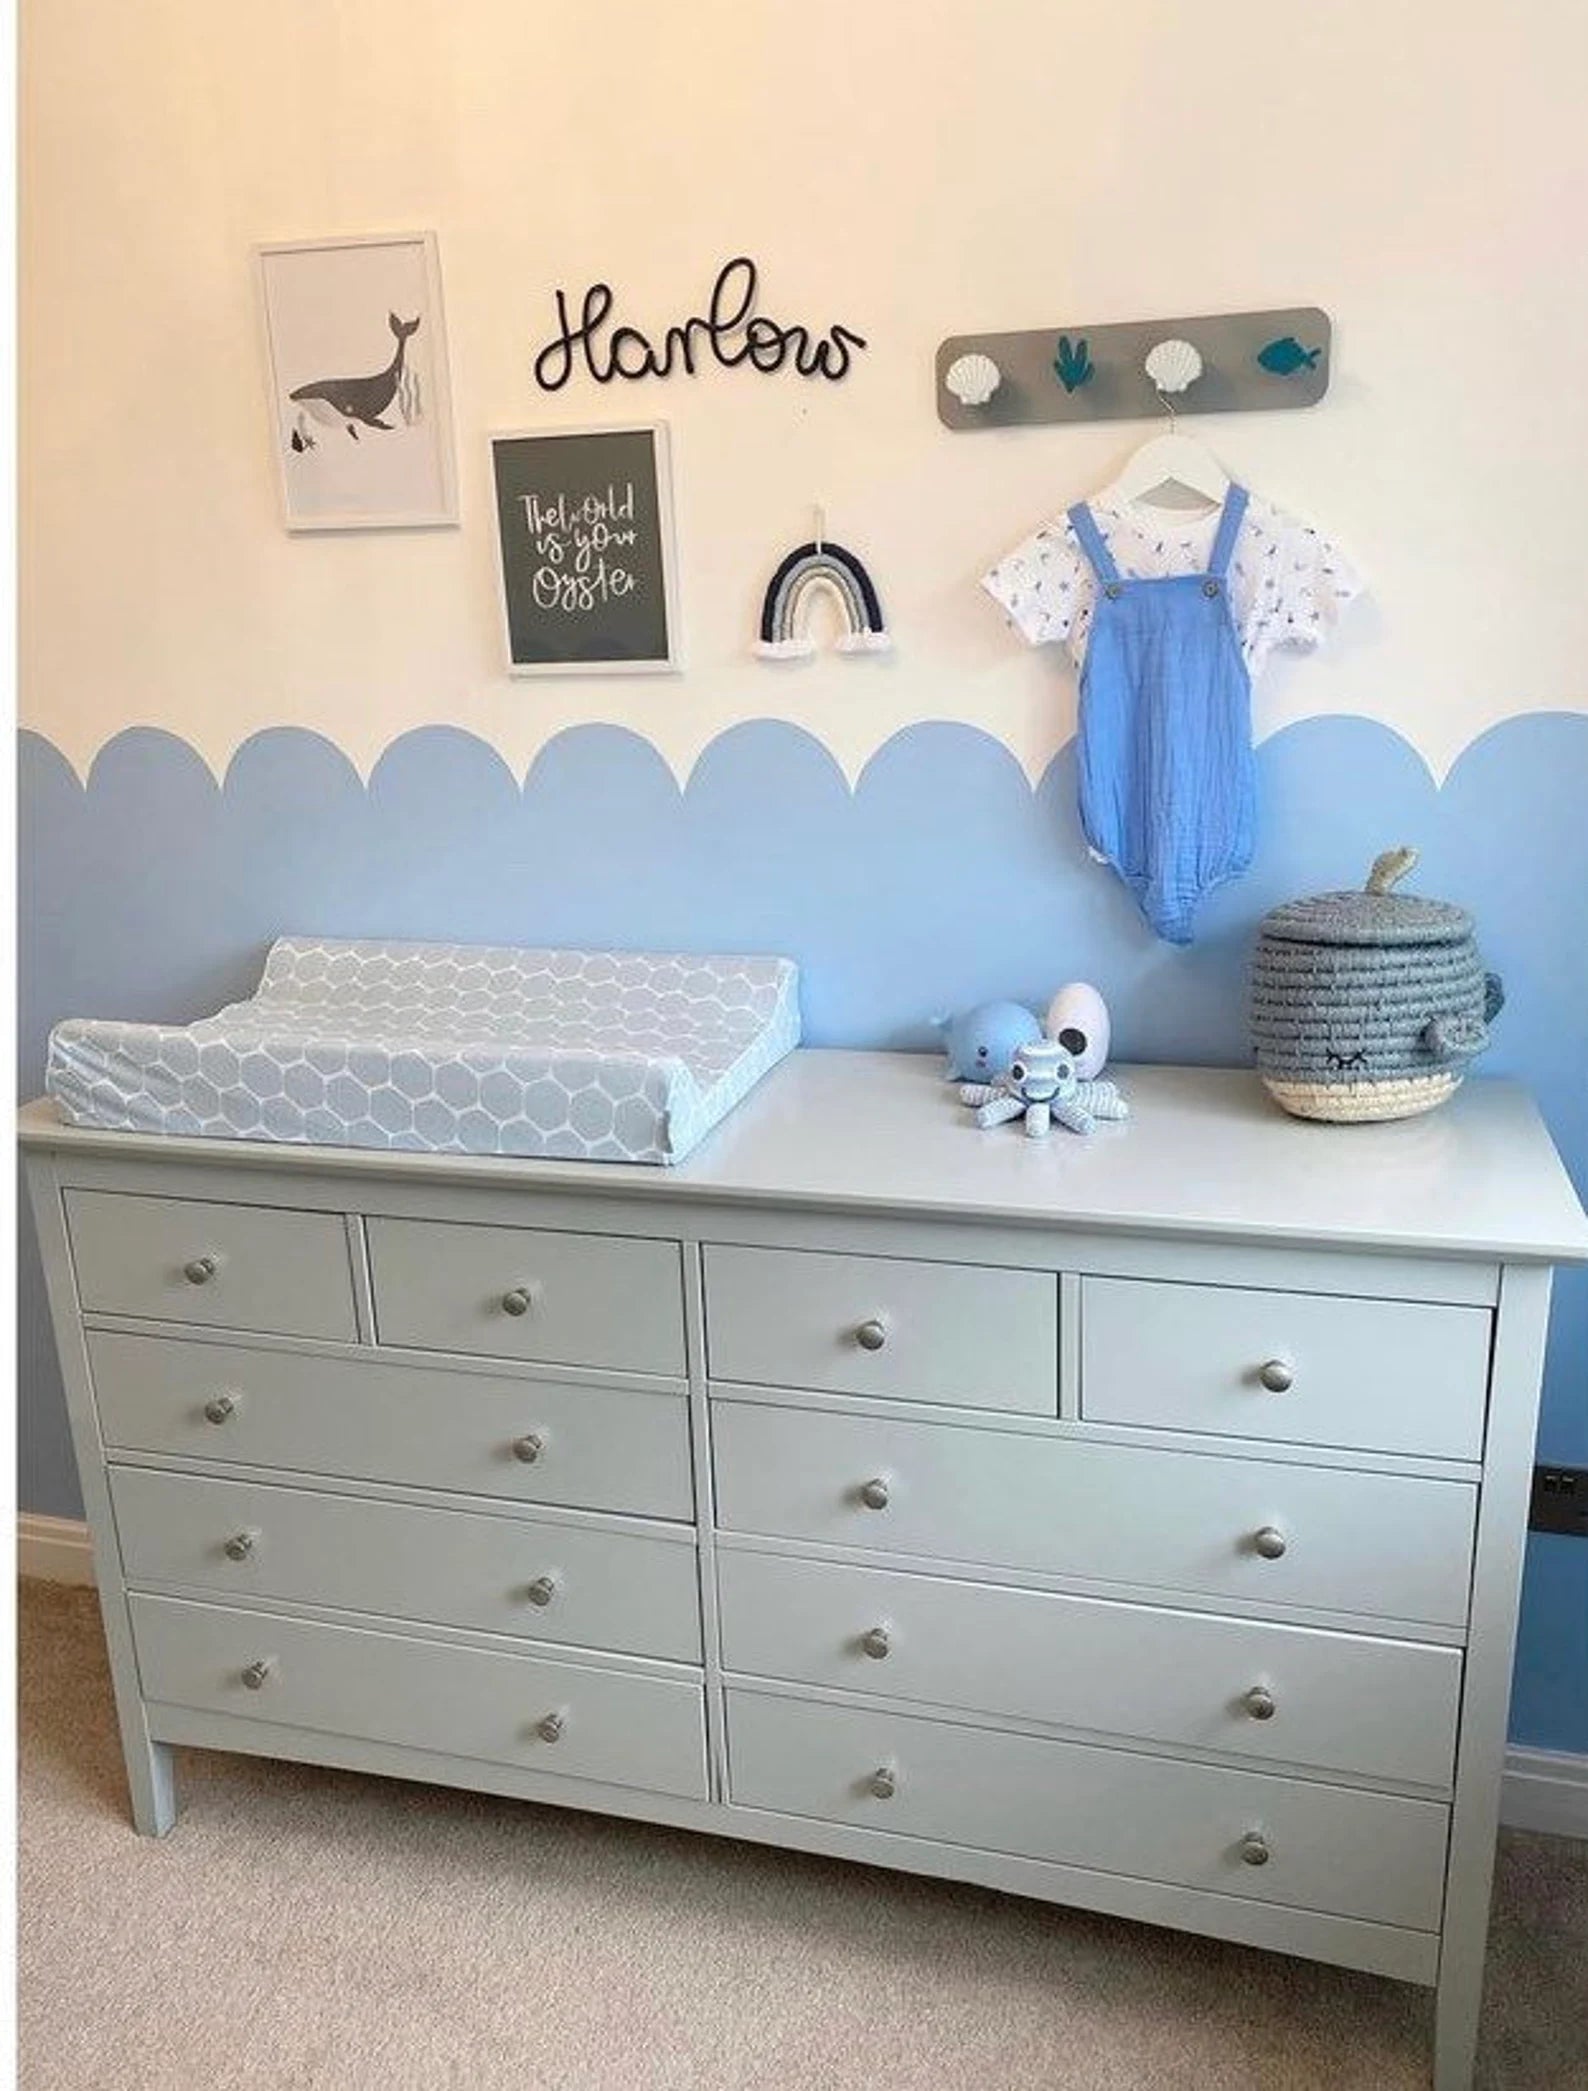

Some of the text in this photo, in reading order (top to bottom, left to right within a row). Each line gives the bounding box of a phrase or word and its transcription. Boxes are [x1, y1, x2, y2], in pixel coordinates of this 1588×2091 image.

[535, 257, 867, 391] Harlow
[520, 495, 558, 533] The
[536, 523, 637, 573] is your
[533, 557, 635, 610] Oyster
